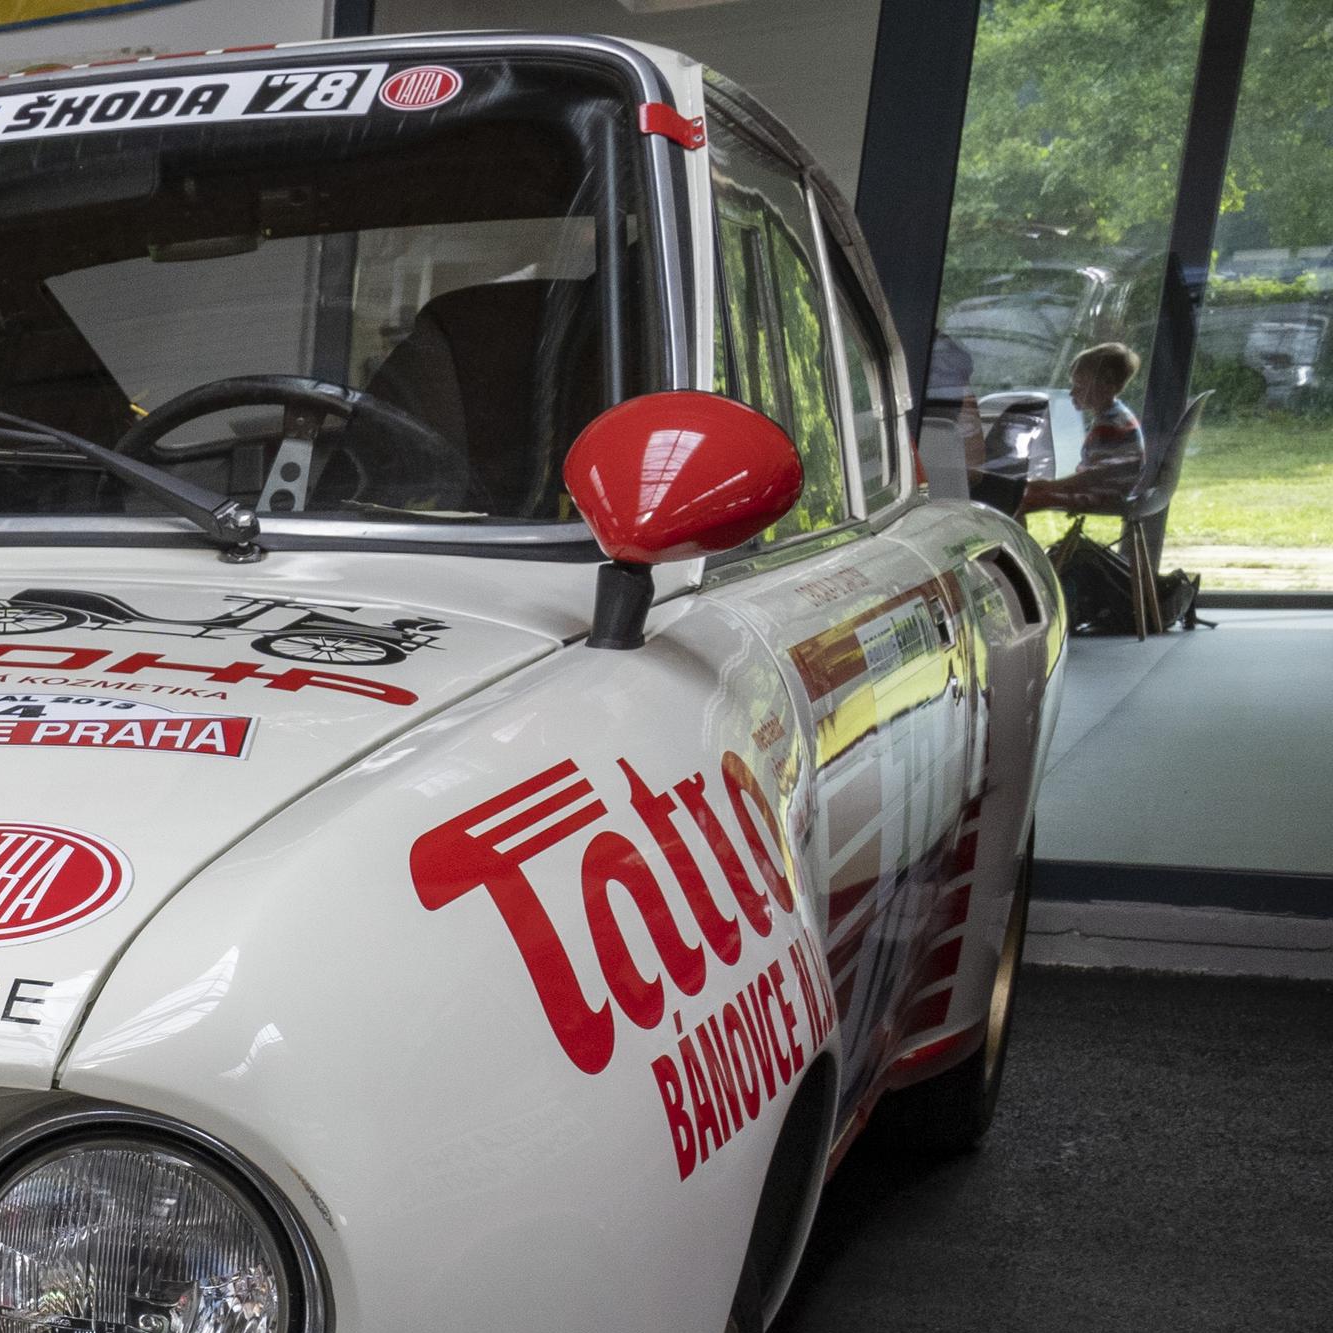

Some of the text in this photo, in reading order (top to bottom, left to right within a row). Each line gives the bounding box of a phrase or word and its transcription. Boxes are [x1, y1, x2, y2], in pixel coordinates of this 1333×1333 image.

[2, 83, 231, 135] ŠKODA
[269, 70, 350, 111] '78
[15, 674, 230, 701] KOZMETIKA
[30, 718, 229, 753] PRAHA
[651, 958, 805, 1183] BÁNOVCE
